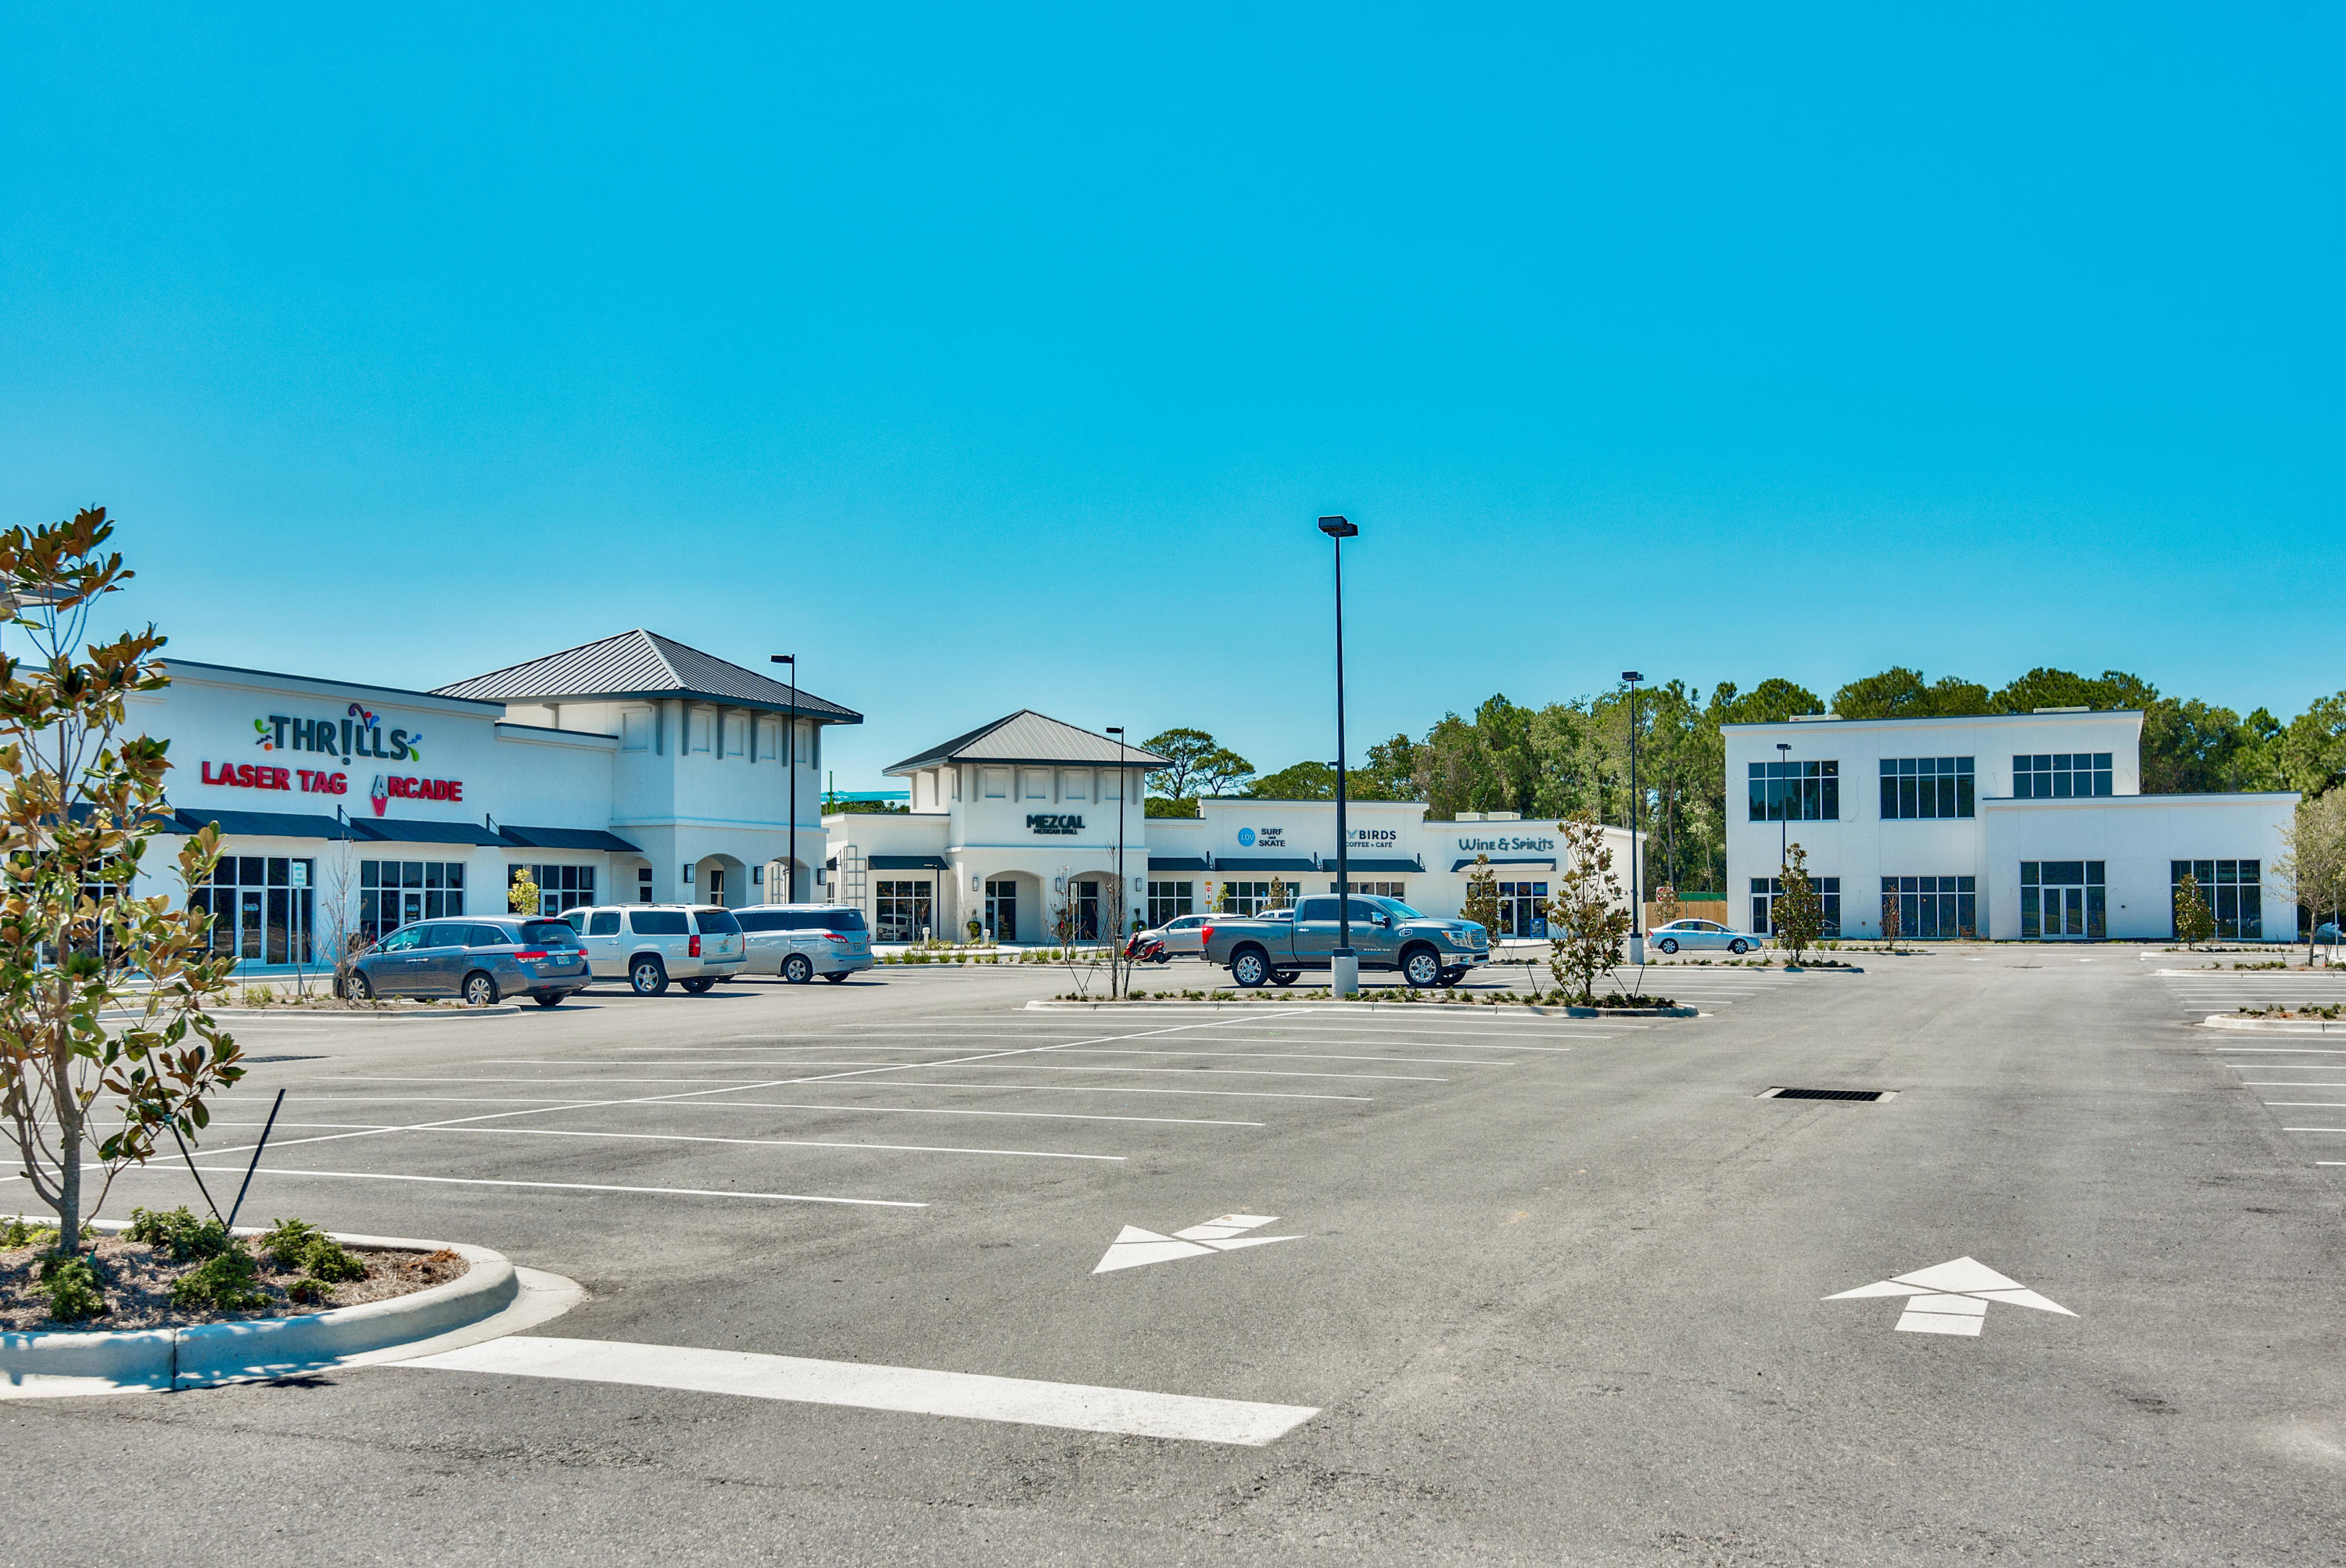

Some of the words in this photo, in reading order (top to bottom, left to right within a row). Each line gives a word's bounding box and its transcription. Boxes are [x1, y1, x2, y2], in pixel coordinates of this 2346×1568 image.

[202, 761, 291, 791] LASER
[297, 769, 348, 795] TAG
[371, 775, 463, 802] ARCADE
[1026, 815, 1085, 828] MEZCAL
[1359, 830, 1397, 840] BIRDS
[1498, 838, 1510, 851] &
